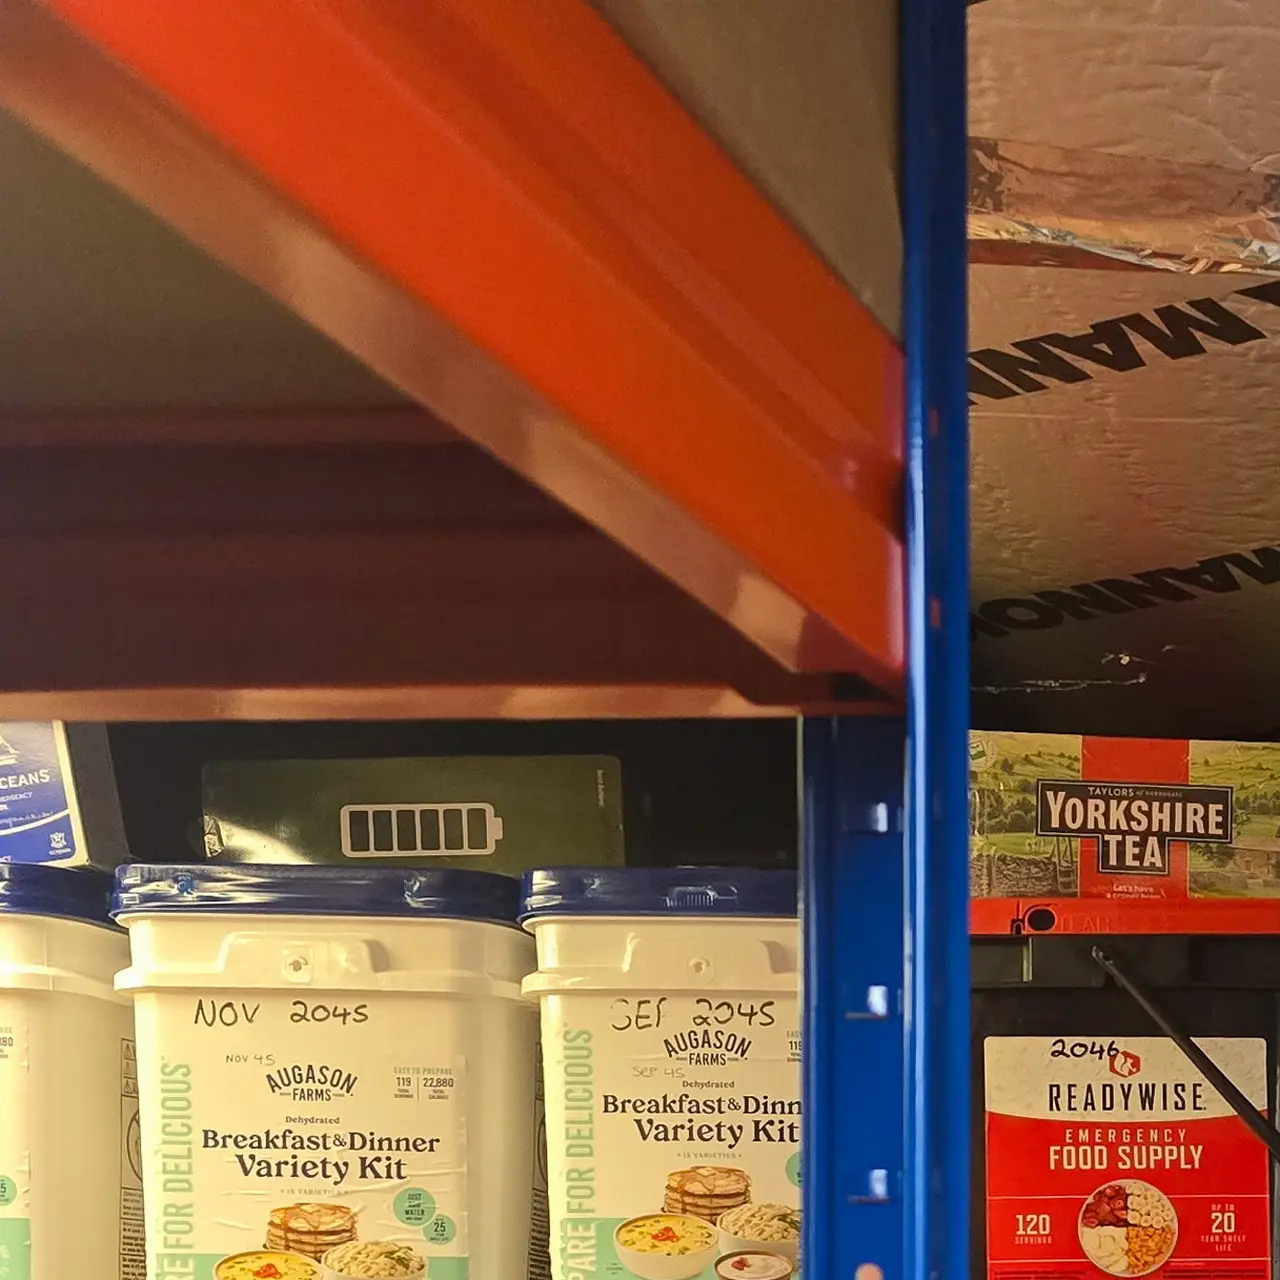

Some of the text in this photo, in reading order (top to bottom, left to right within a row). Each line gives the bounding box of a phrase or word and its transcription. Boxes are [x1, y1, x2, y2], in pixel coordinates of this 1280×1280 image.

[967, 299, 1265, 405] MANN
[1088, 787, 1134, 797] TAYLORS
[1046, 791, 1223, 835] YORKSHIRE
[1104, 834, 1163, 867] TEA
[194, 999, 369, 1027] NOV 2045
[663, 1030, 752, 1059] AUGASON
[1050, 1039, 1120, 1060] 2046
[226, 1054, 248, 1064] NOV
[689, 1053, 726, 1066] FARMS
[265, 1064, 358, 1094] AUGASON
[395, 1076, 411, 1087] 119
[682, 1080, 735, 1090] Dehydrated
[292, 1088, 331, 1102] FARMS
[602, 1093, 726, 1114] Breakfast
[1049, 1083, 1204, 1111] READYWISE
[161, 1062, 194, 1193] DELICIOUS
[285, 1115, 340, 1125] Dehydrated
[202, 1129, 441, 1152] Breakfast Dinner
[633, 1118, 800, 1149] Variety Kit
[1065, 1128, 1187, 1143] EMERGENCY
[1049, 1145, 1203, 1170] FOOD SUPPLY
[235, 1153, 407, 1185] Variety Kit
[163, 1204, 194, 1250] FOR
[433, 1222, 446, 1233] 25
[1016, 1214, 1050, 1234] 120
[1210, 1212, 1235, 1232] 20
